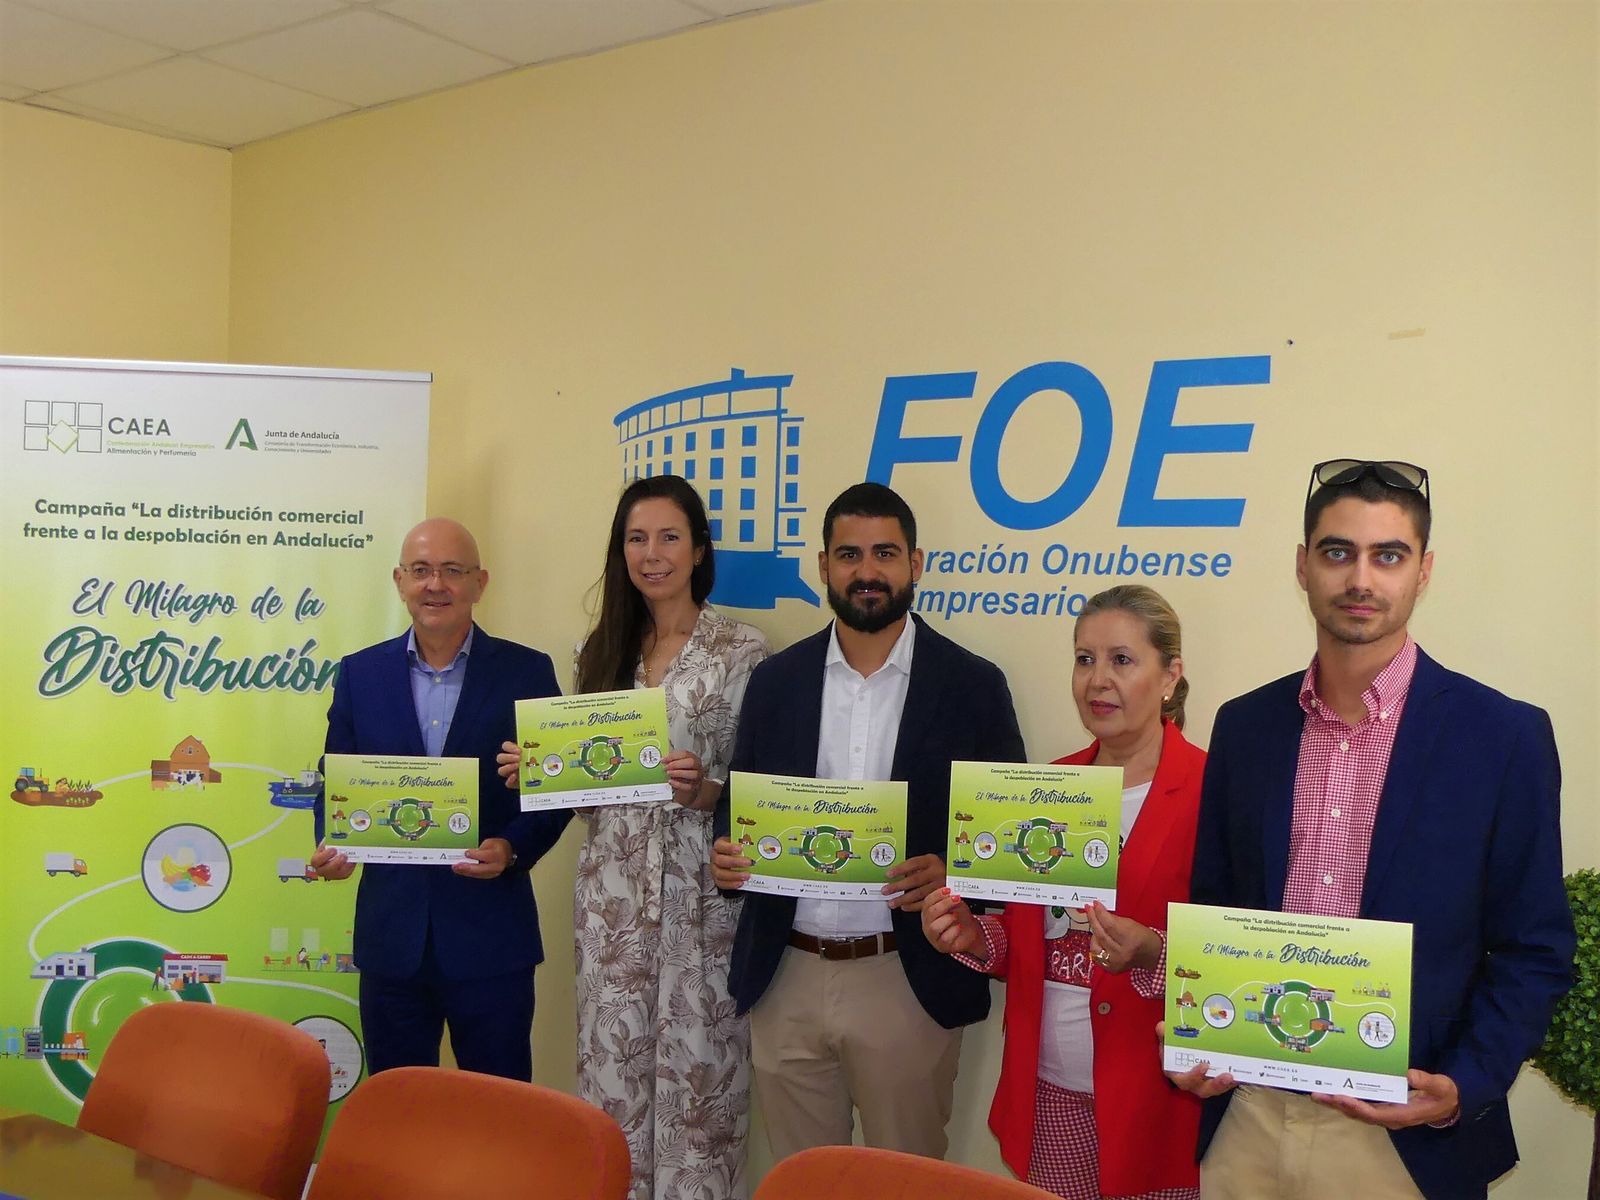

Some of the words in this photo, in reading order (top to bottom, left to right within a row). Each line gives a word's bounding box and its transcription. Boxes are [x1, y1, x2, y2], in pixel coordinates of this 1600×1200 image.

[108, 417, 171, 436] CAEA
[265, 430, 287, 438] Junta
[289, 430, 299, 438] de
[300, 431, 340, 440] Andalucía
[863, 355, 1272, 531] FOE
[35, 499, 126, 518] Campaña
[167, 503, 273, 522] distribución
[278, 510, 364, 525] comercial
[23, 522, 78, 538] frente
[84, 529, 96, 540] a
[102, 526, 118, 540] la
[124, 527, 241, 545] despoblación
[247, 533, 267, 545] en
[924, 543, 1029, 574] ración
[1042, 543, 1232, 578] Onubense
[72, 577, 114, 616] El
[124, 579, 238, 624] Milagro
[250, 585, 284, 623] de
[294, 587, 326, 623] la
[911, 583, 1088, 621] mpresario
[38, 626, 342, 700] Distribución
[588, 710, 642, 727] Distribución
[399, 774, 454, 788] Distribución
[813, 799, 879, 815] Distribución
[1029, 788, 1094, 805] Distribución
[1224, 915, 1251, 923] Campaña
[1263, 919, 1297, 927] distribución
[1298, 922, 1325, 930] comercial
[1250, 926, 1287, 934] despoblación
[1203, 943, 1213, 954] El
[1217, 944, 1249, 958] Milagro
[1253, 948, 1263, 959] de
[1266, 950, 1275, 960] la
[1279, 943, 1371, 968] Distribución
